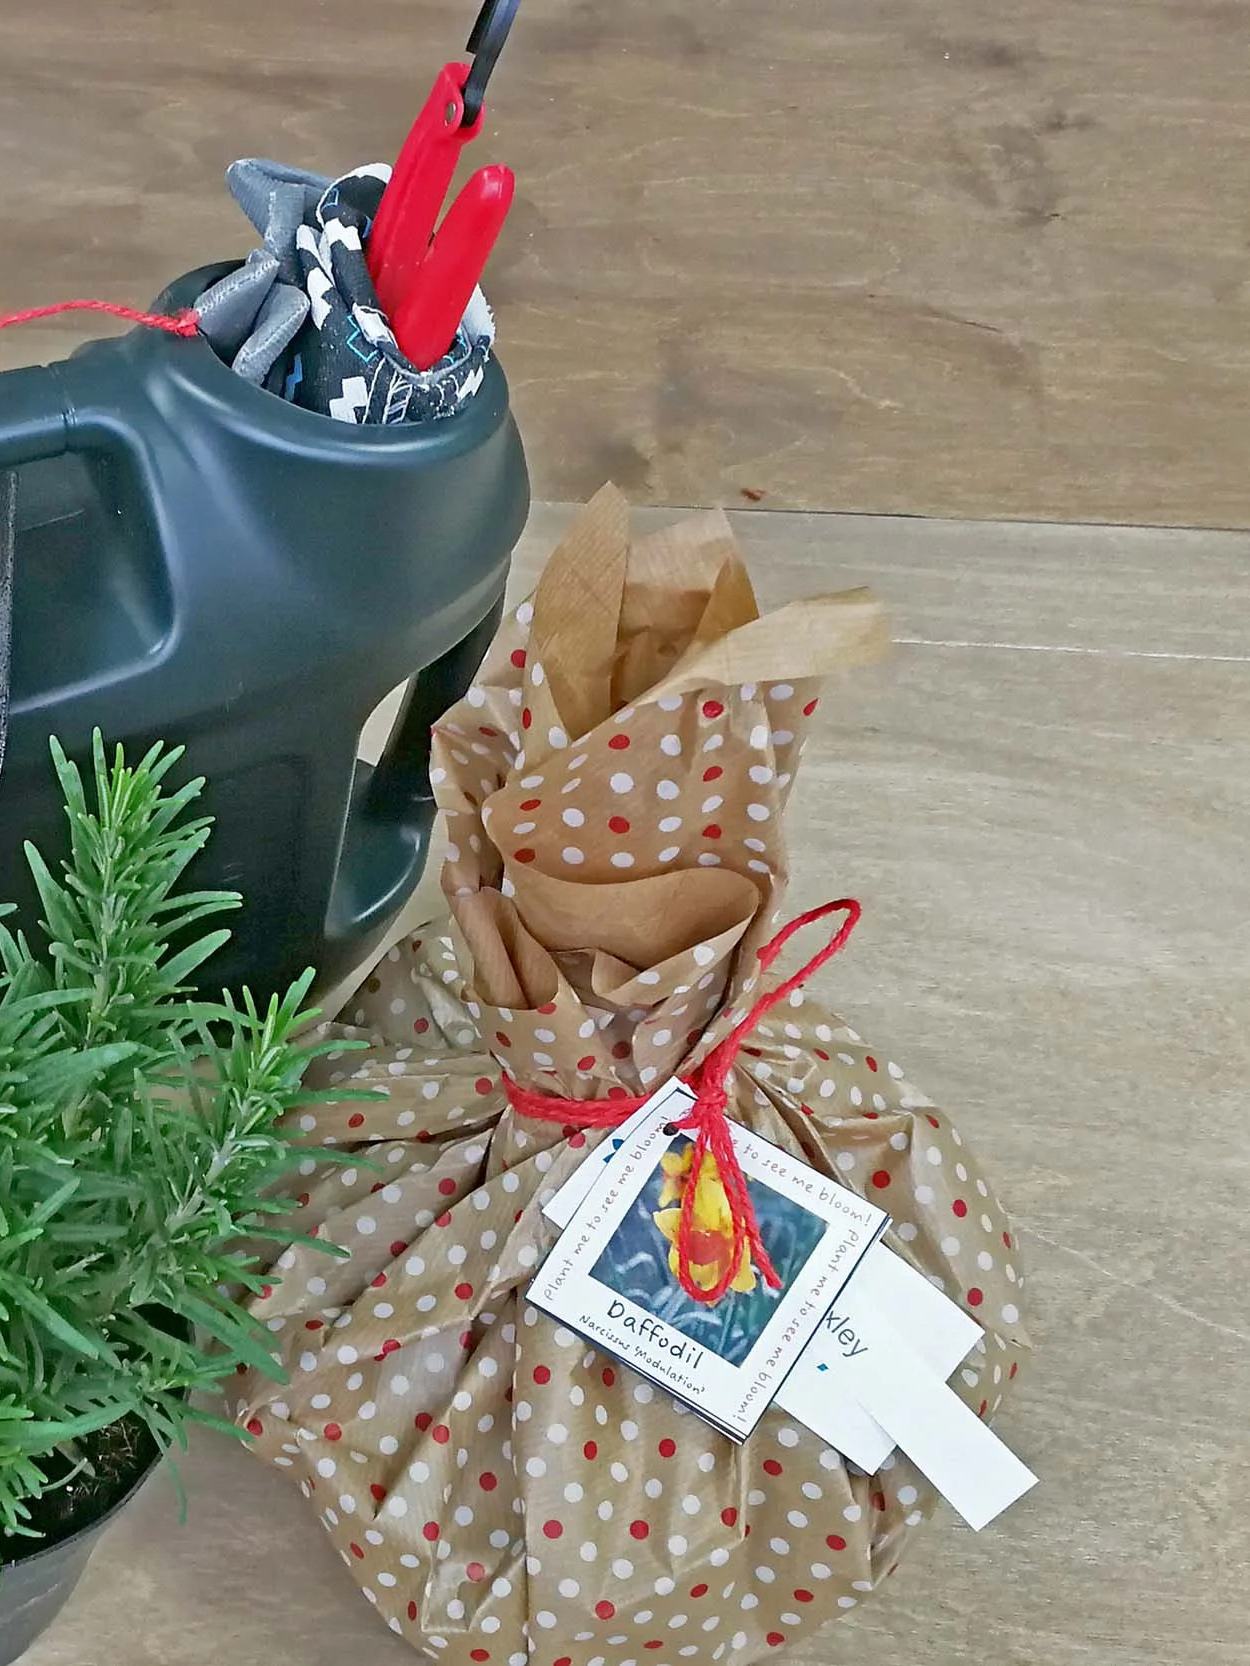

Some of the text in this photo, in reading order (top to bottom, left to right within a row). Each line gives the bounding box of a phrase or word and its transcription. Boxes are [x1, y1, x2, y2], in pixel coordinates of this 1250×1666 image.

[575, 1235, 590, 1255] me
[586, 1215, 601, 1231] to
[604, 1189, 619, 1213] see
[618, 1164, 635, 1185] me
[629, 1116, 673, 1161] bloom!
[743, 1144, 758, 1160] to
[761, 1159, 787, 1178] see
[792, 1175, 814, 1192] me
[819, 1187, 873, 1226] bloom!
[810, 1276, 828, 1296] me
[799, 1300, 816, 1316] to
[579, 1314, 631, 1351] Narcissus
[607, 1299, 704, 1369] Daffodil
[781, 1318, 800, 1342] see
[766, 1346, 782, 1367] me
[732, 1371, 773, 1423] bloom!
